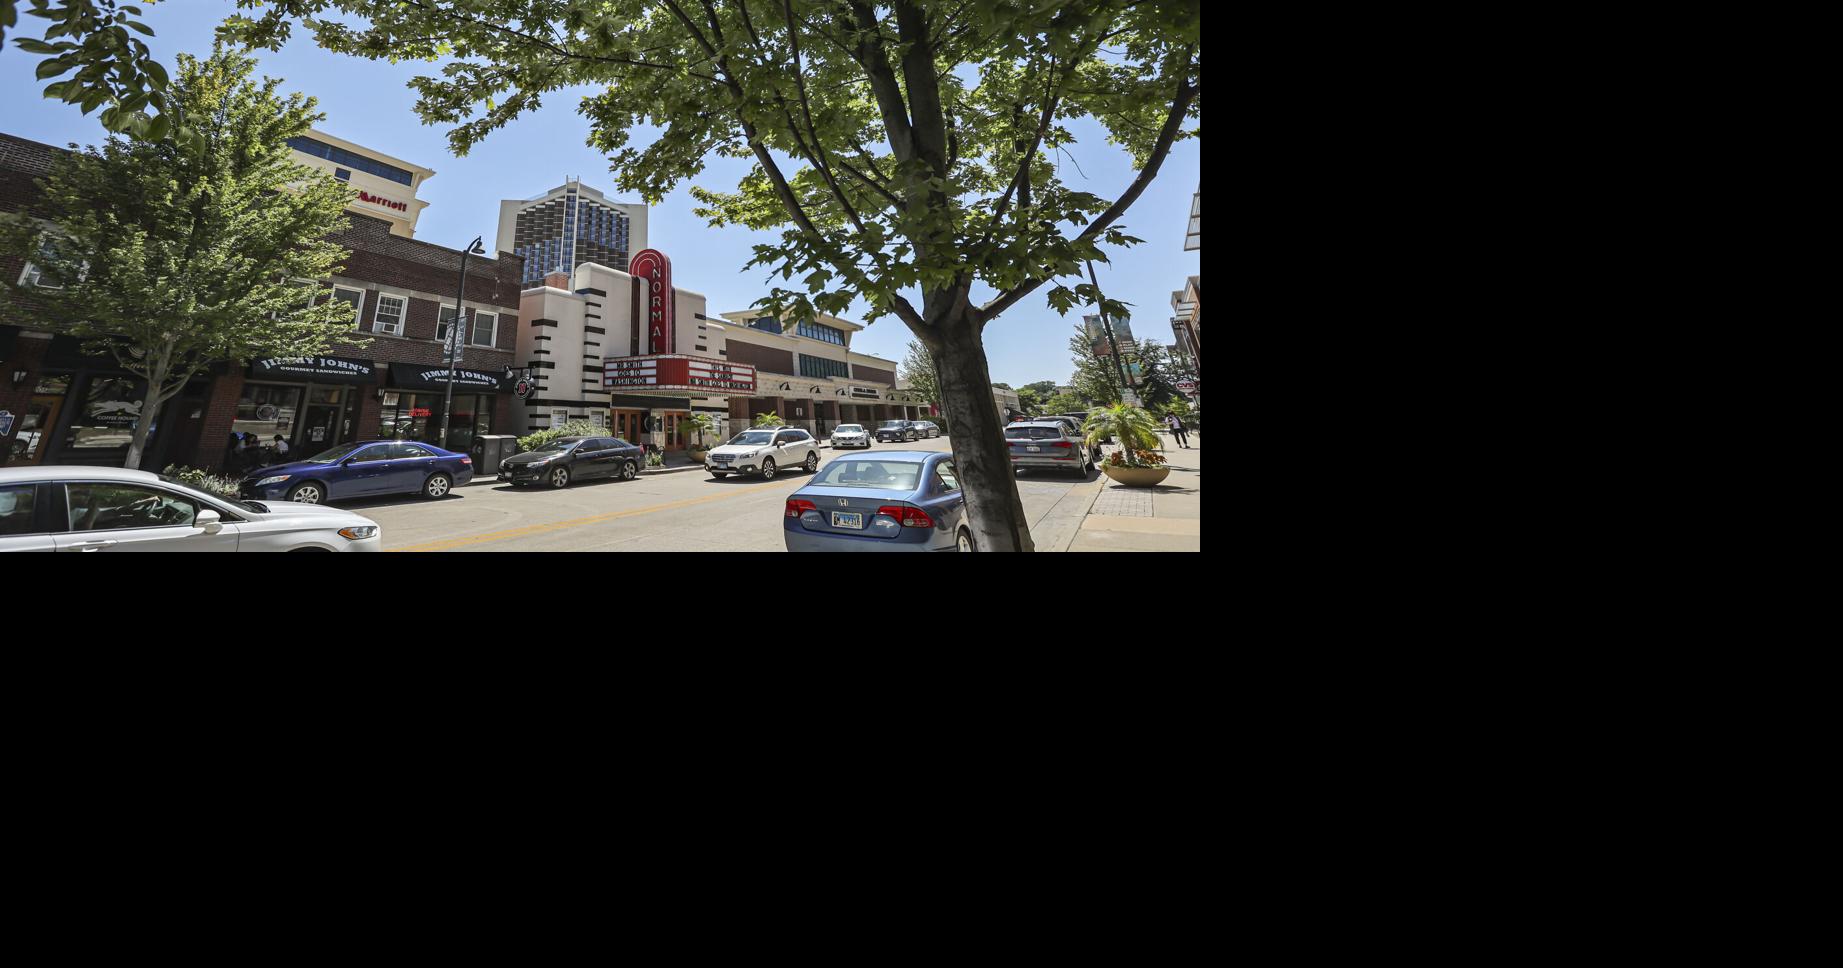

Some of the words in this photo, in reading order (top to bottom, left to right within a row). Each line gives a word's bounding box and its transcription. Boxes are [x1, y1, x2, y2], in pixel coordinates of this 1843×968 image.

[652, 268, 662, 352] NORMAL
[320, 358, 370, 374] JOHN'S
[460, 370, 497, 384] JOHN'S
[612, 377, 647, 385] WASHINGTON
